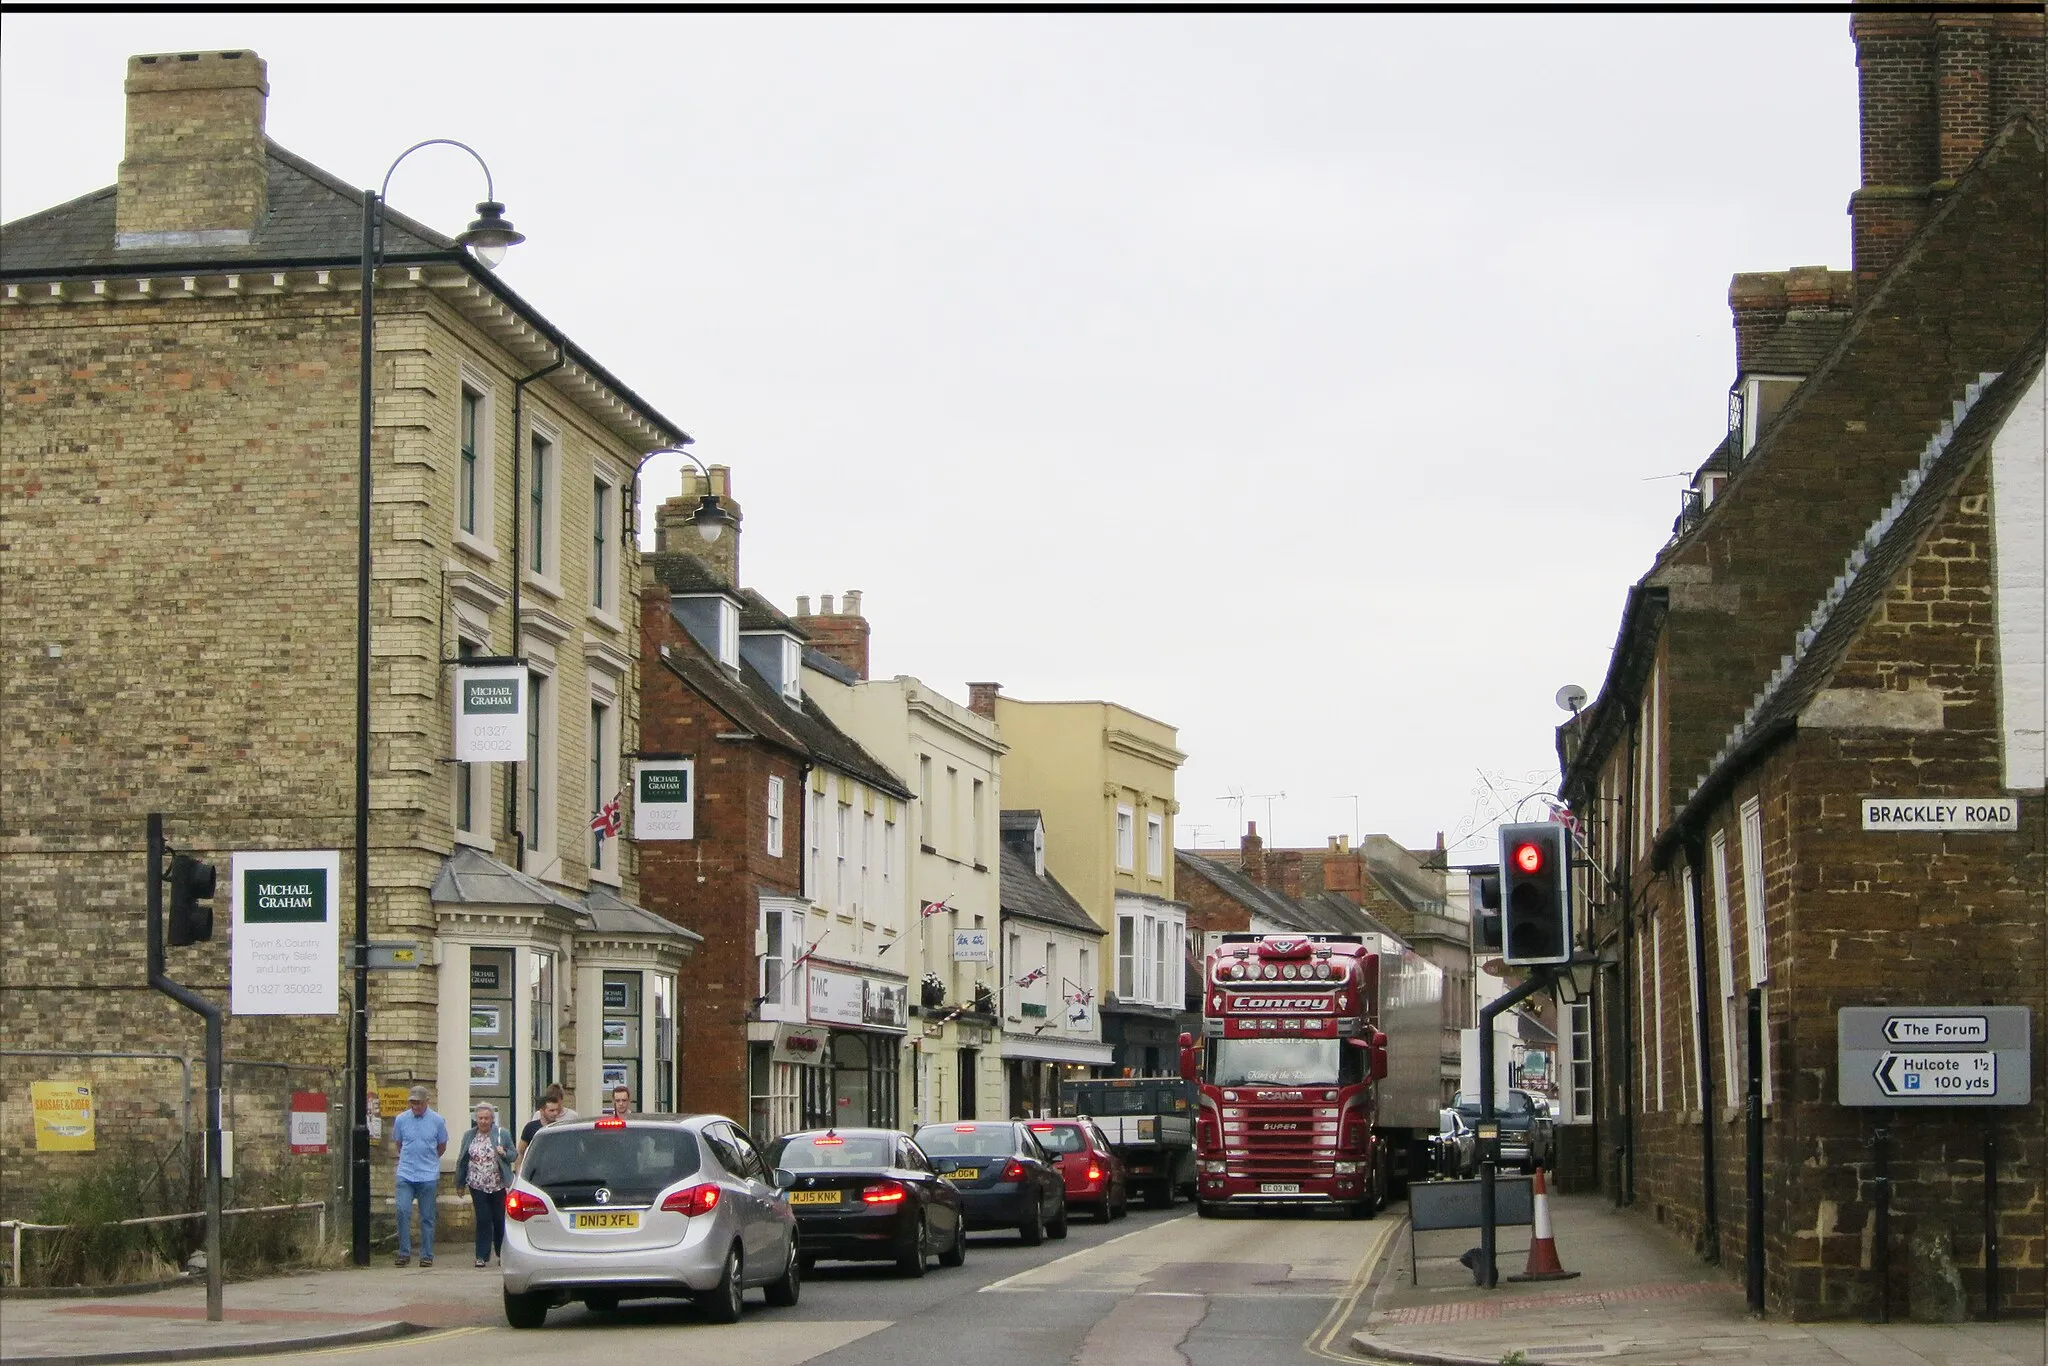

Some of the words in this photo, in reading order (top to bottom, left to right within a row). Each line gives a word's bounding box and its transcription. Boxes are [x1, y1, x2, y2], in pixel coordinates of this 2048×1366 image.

[470, 687, 512, 696] MICHAEL
[470, 696, 512, 706] GRAHAM
[474, 726, 508, 737] 01327
[470, 740, 512, 751] 350022
[649, 810, 678, 819] 01327
[1869, 806, 1957, 822] BRACKLEY
[1965, 806, 2011, 822] ROAD
[647, 822, 681, 831] 350022
[258, 884, 313, 896] MICHAEL
[258, 896, 313, 909] GRAHAM
[249, 939, 273, 949] Town
[275, 939, 283, 948] &
[285, 938, 320, 950] Country
[252, 951, 290, 962] Property
[293, 951, 318, 961] Sales
[256, 964, 274, 974] and
[276, 964, 312, 975] Lettings
[247, 984, 280, 994] 01327
[283, 984, 323, 994] 350022
[811, 975, 829, 998] TMC
[1233, 996, 1329, 1010] Conroy
[1903, 1024, 1930, 1035] The
[1935, 1024, 1980, 1035] Forum
[1904, 1059, 1960, 1070] Hulcote
[1934, 1076, 1962, 1088] 100
[1965, 1076, 1989, 1090] yds
[1256, 1091, 1304, 1101] SCANIA
[817, 1192, 837, 1201] KNK
[580, 1215, 607, 1227] DN13
[610, 1214, 634, 1226] XFL
